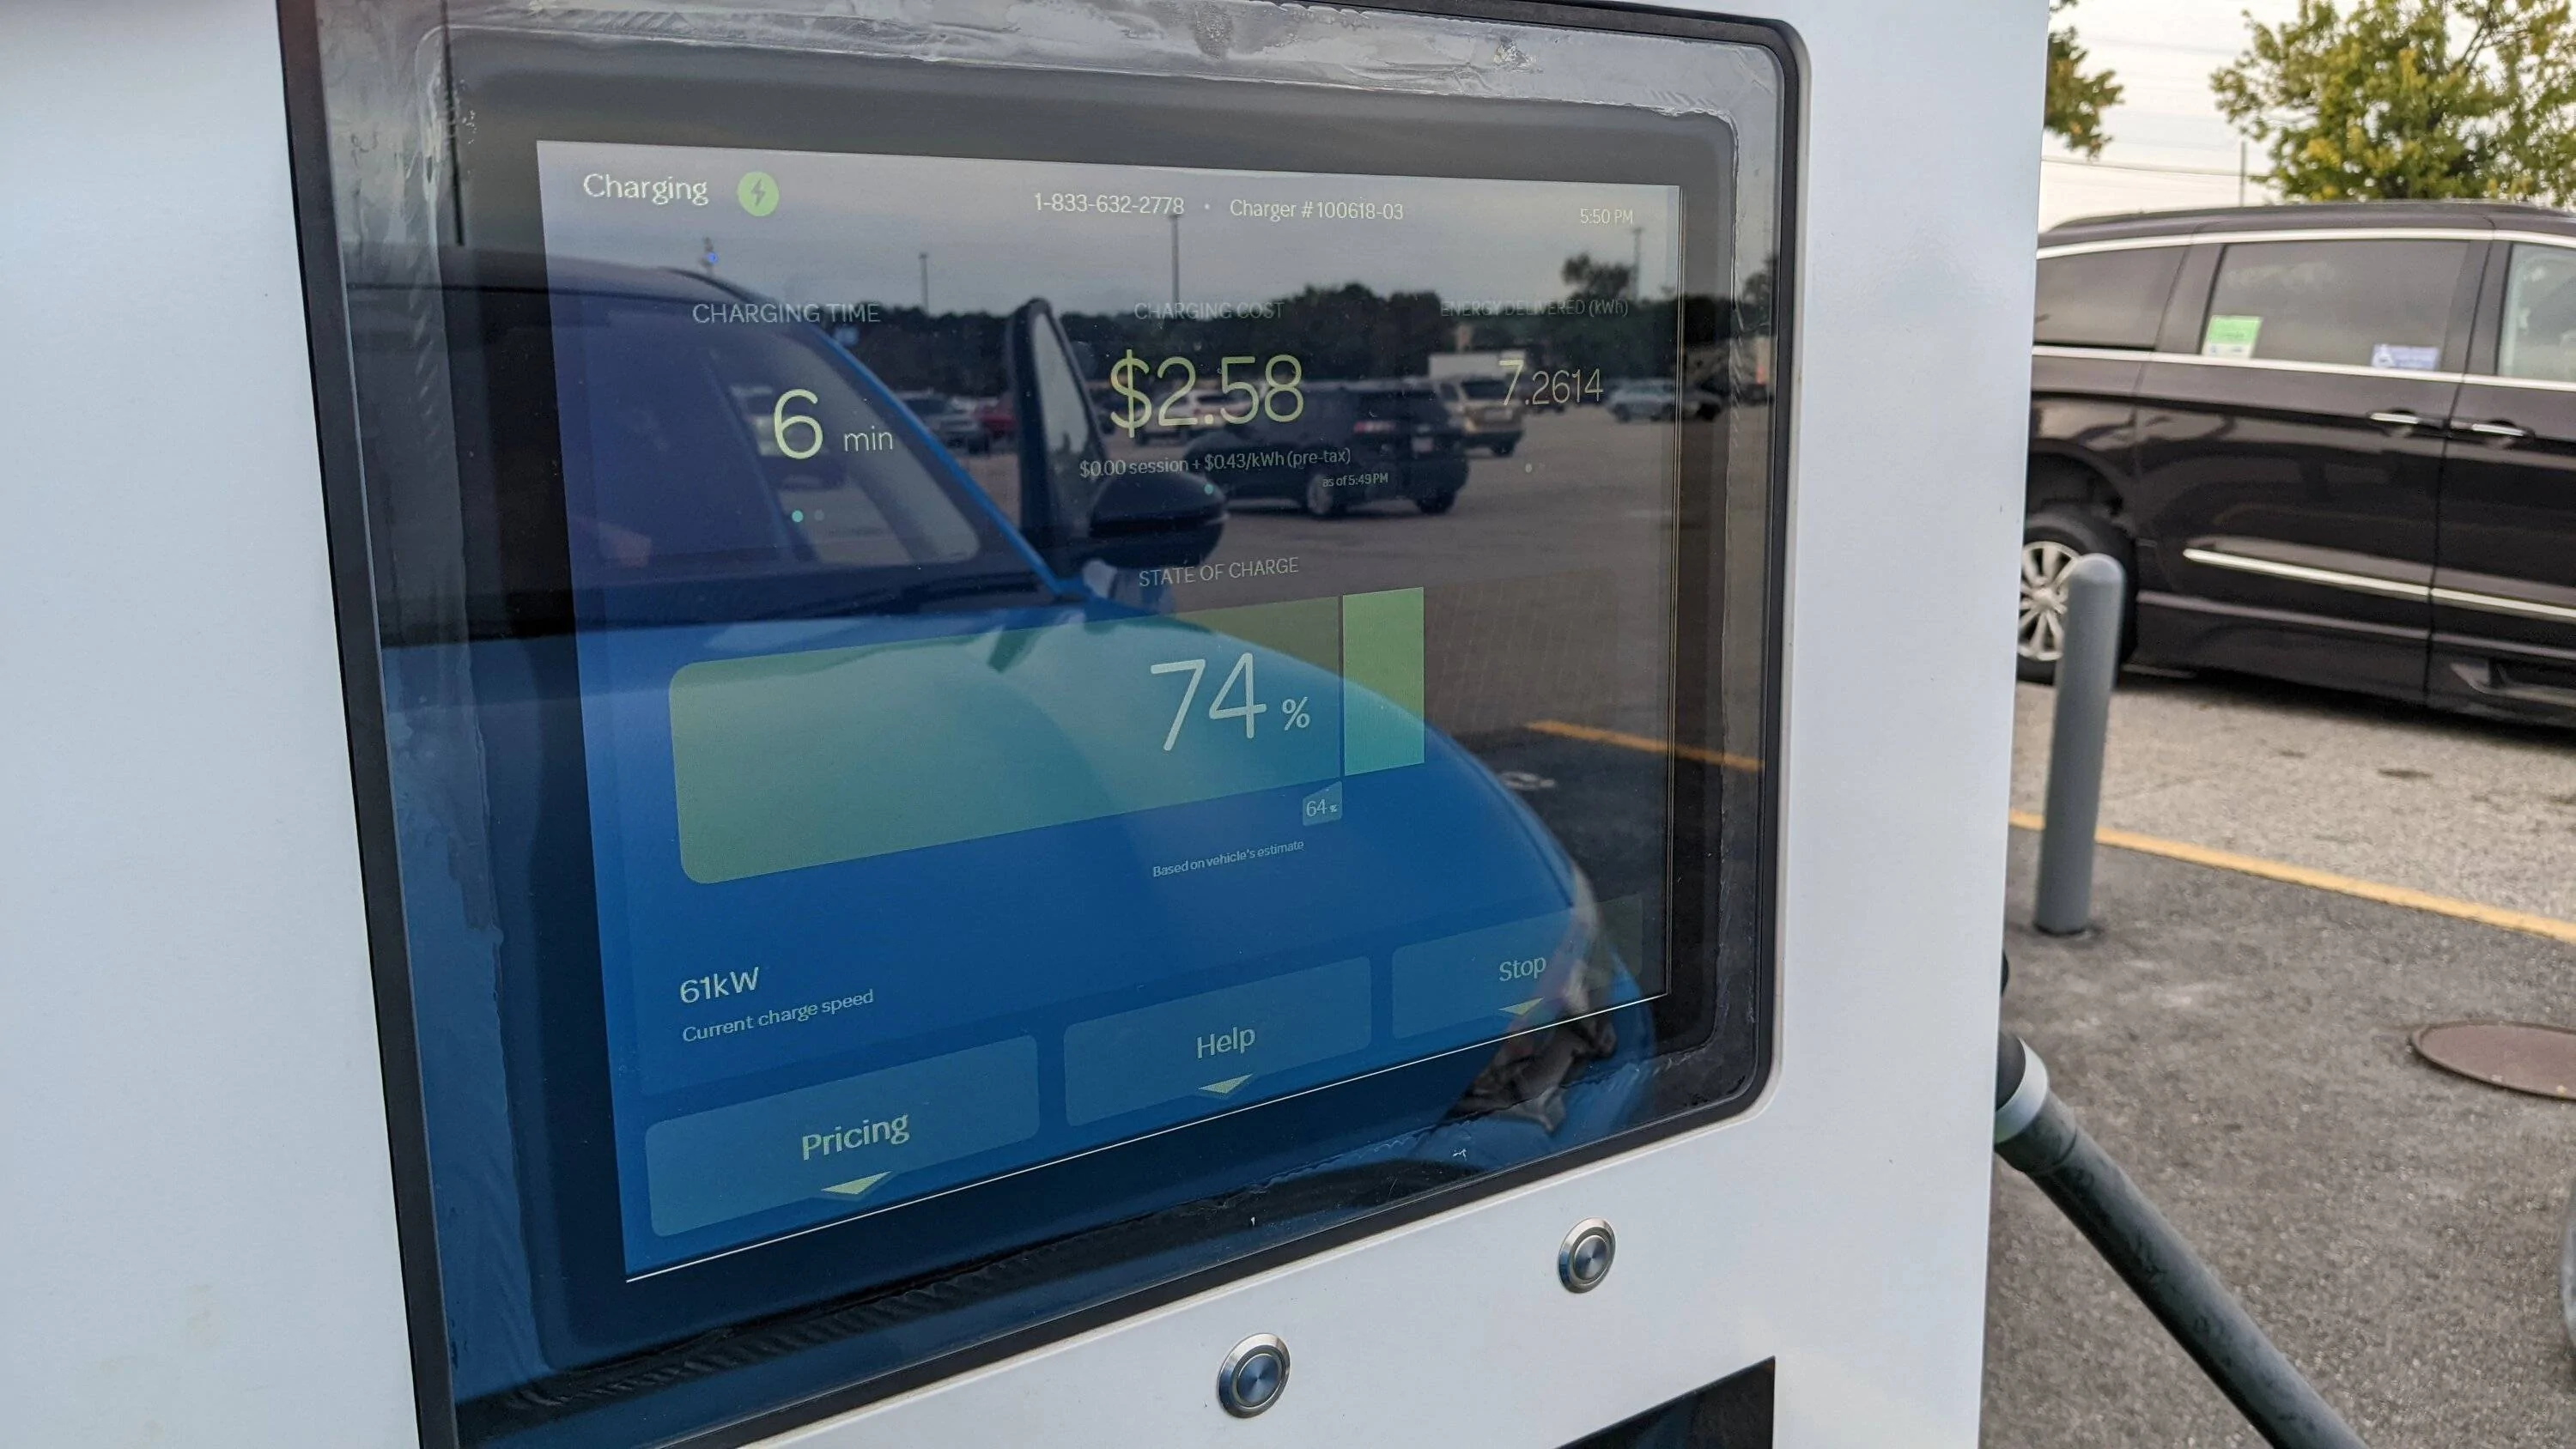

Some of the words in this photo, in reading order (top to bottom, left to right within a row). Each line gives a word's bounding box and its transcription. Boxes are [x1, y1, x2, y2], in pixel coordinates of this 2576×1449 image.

[584, 173, 709, 206] Charging
[1034, 193, 1185, 215] 1-833-632-2778
[1230, 199, 1297, 222] Charger
[1579, 208, 1611, 225] 5:50
[1614, 209, 1633, 224] PM
[692, 303, 820, 324] CHARGING
[823, 303, 880, 324] TIME
[1134, 302, 1232, 320] CHARGING
[1236, 301, 1285, 319] COST
[1441, 300, 1502, 317] ENERGY
[1504, 299, 1585, 316] DELIVERED
[1589, 299, 1629, 317] (kWh)
[1110, 349, 1304, 439] $2.58
[1499, 359, 1604, 406] 7.2614
[774, 389, 823, 459] 6
[843, 426, 893, 452] min
[1079, 459, 1126, 478] $0.00
[1129, 458, 1189, 476] session
[1204, 451, 1285, 471] $0.43/kWh
[1288, 447, 1351, 469] (pre-tax)
[1322, 477, 1334, 488] as
[1335, 476, 1348, 487] of
[1348, 474, 1371, 487] 5:49
[1372, 472, 1388, 485] PM
[1139, 566, 1195, 587] STATE
[1200, 563, 1225, 583] OF
[1229, 556, 1300, 579] CHARGE
[1150, 652, 1268, 752] 74
[1282, 696, 1310, 731] %
[1306, 798, 1327, 817] 64
[1152, 861, 1189, 877] Based
[1190, 859, 1205, 870] on
[1206, 848, 1255, 867] vehicle's
[1256, 840, 1304, 858] estimate
[679, 966, 760, 1003] 61kW
[1498, 955, 1546, 983] Stop
[683, 1016, 754, 1042] Current
[758, 1003, 818, 1028] charge
[822, 988, 874, 1016] speed
[1196, 1026, 1255, 1060] Help
[802, 1113, 910, 1161] Pricing
